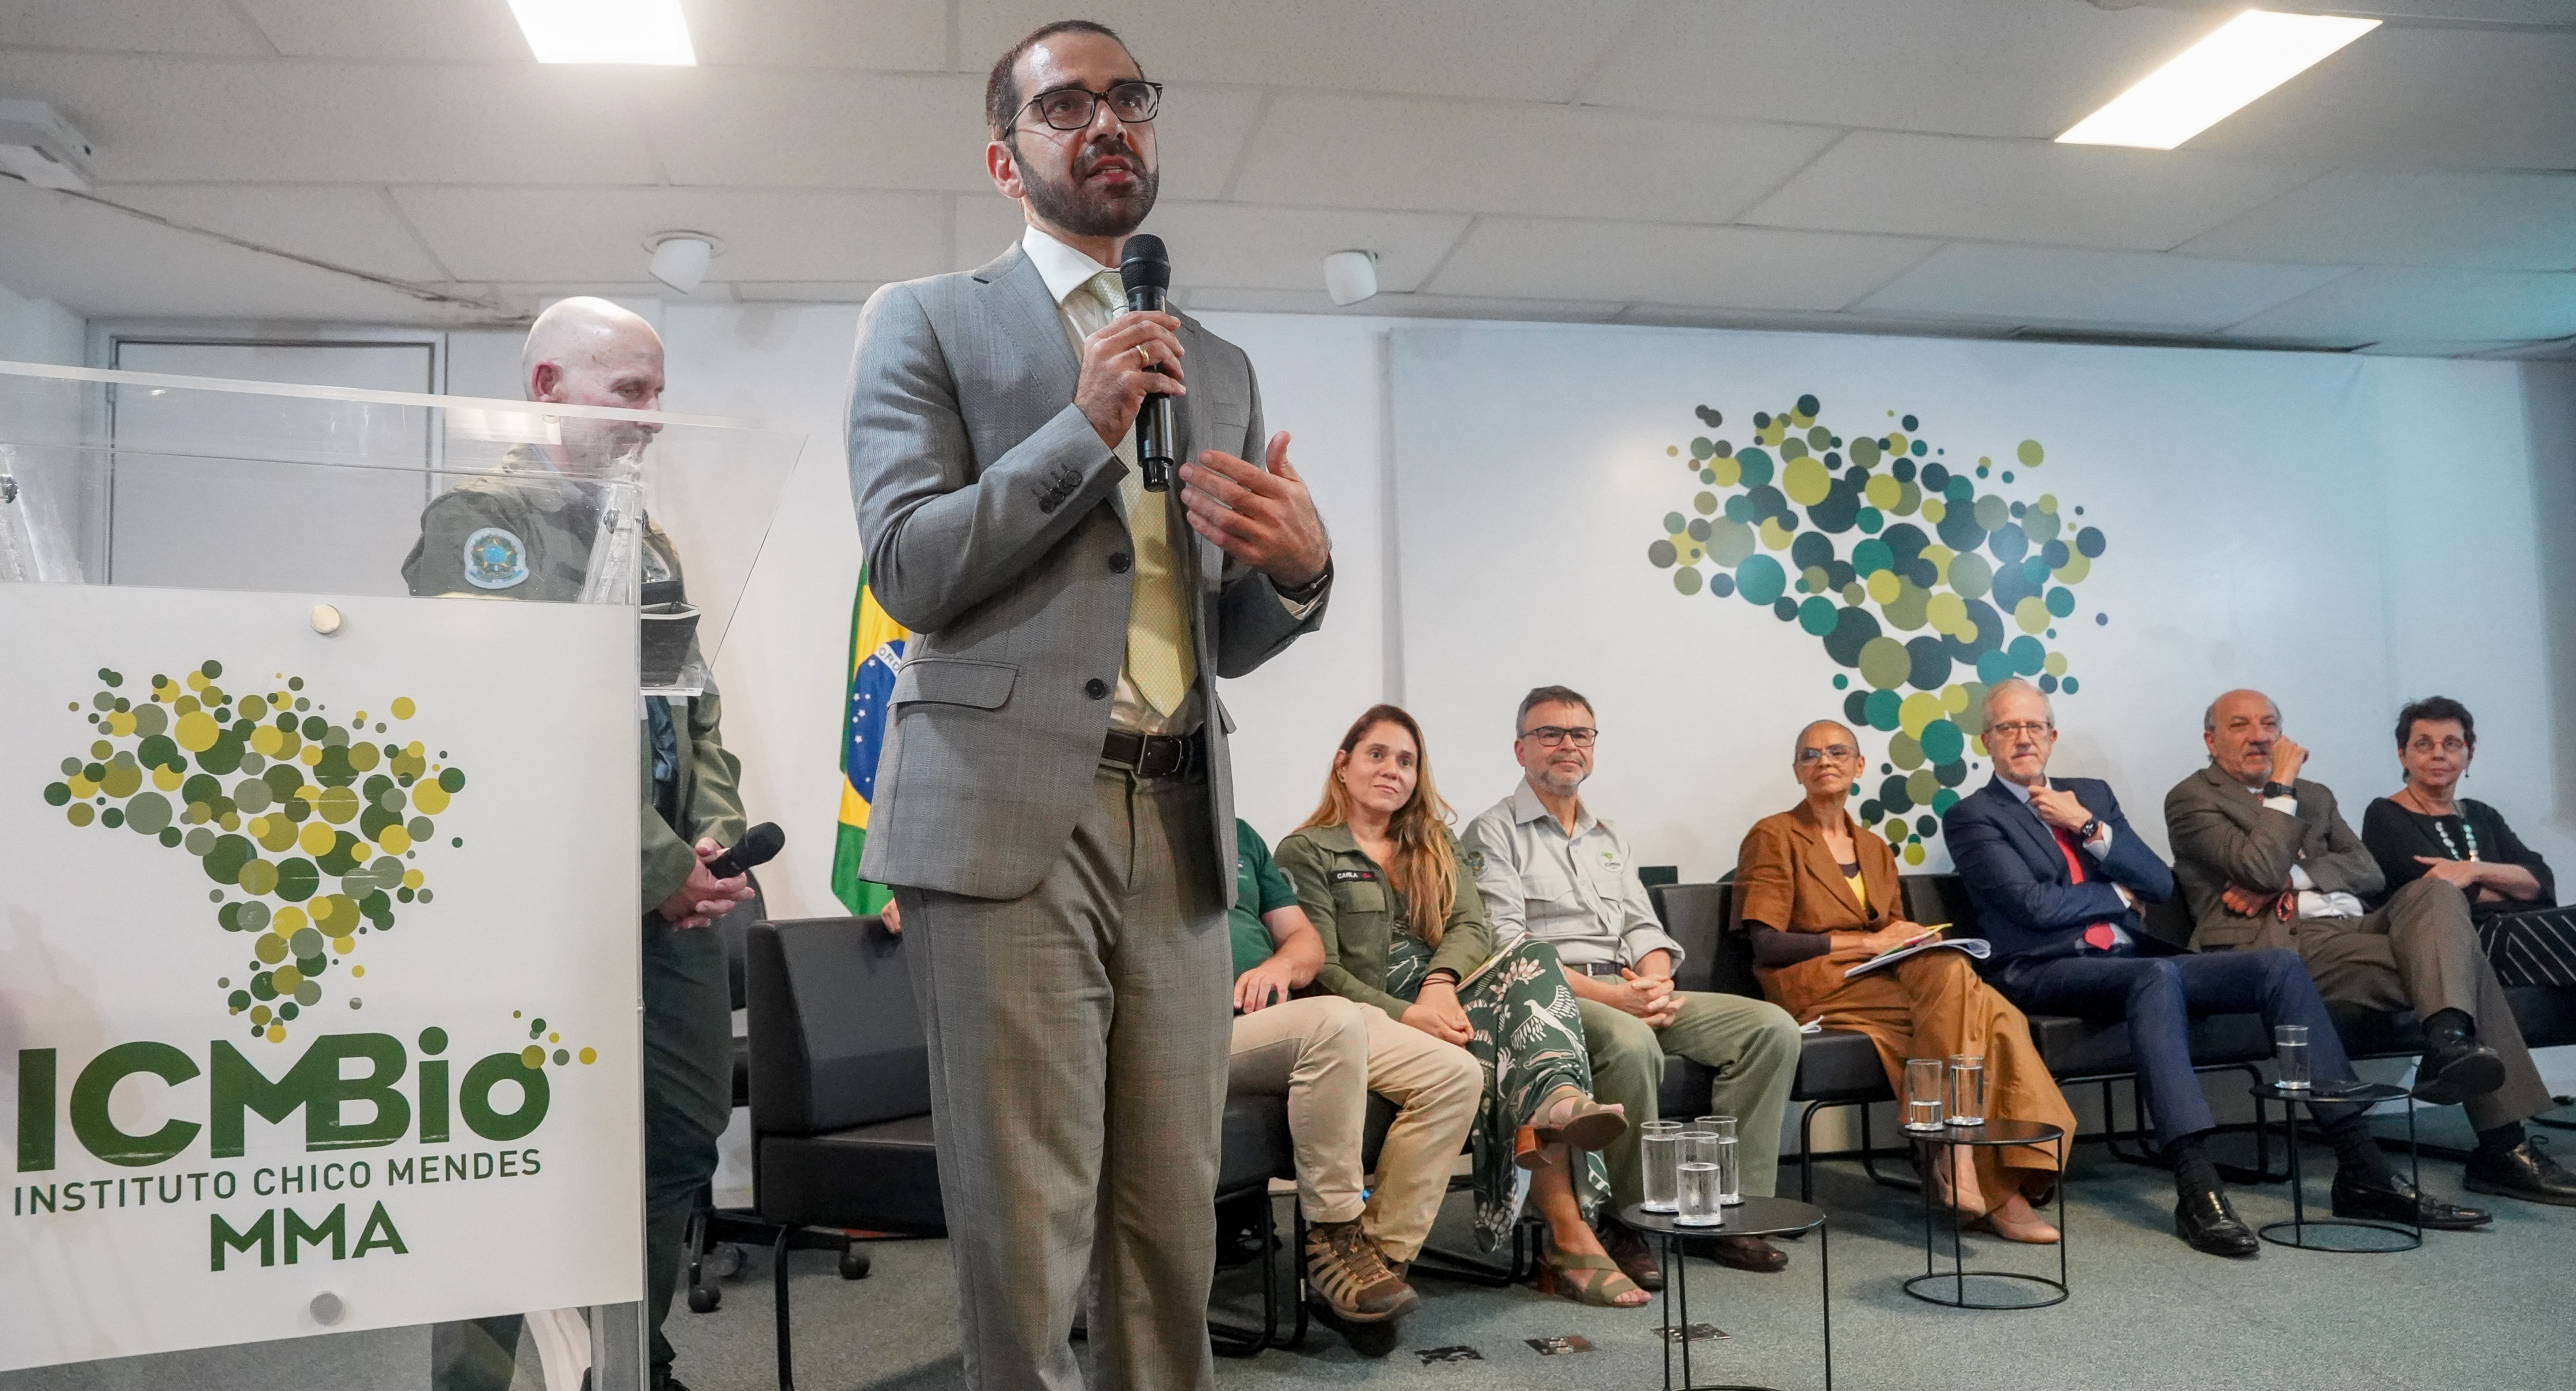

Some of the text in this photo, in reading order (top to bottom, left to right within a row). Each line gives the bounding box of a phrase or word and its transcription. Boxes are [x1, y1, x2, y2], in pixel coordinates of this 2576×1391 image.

[16, 1026, 550, 1173] ICMBio
[14, 1149, 541, 1216] INSTITUTO CHICO MENDES
[210, 1200, 410, 1272] MMA
